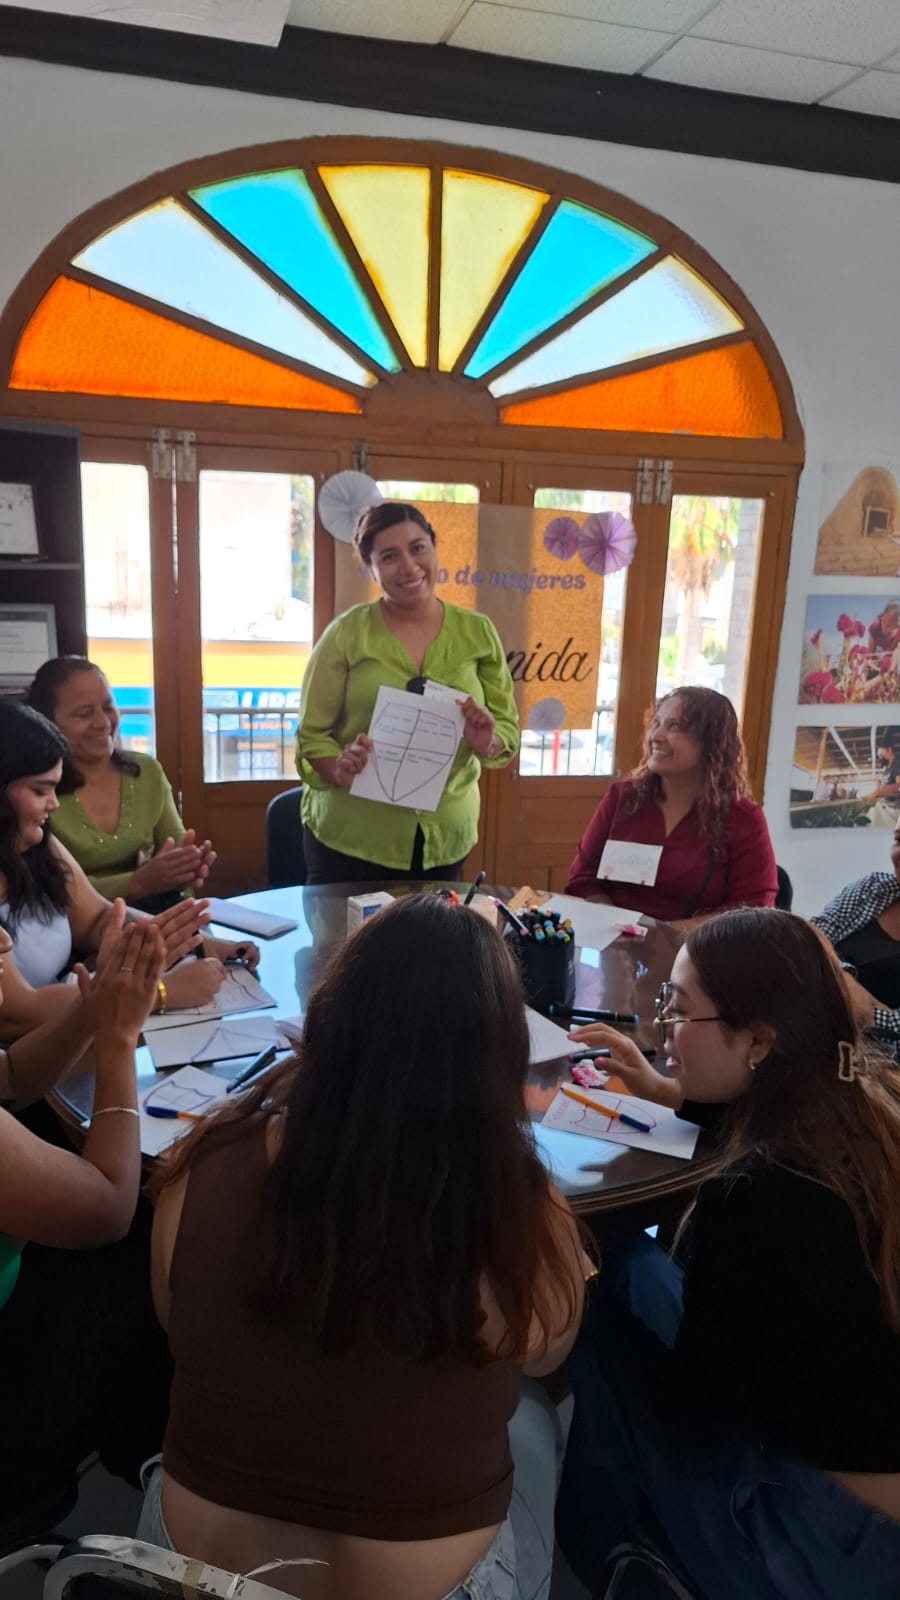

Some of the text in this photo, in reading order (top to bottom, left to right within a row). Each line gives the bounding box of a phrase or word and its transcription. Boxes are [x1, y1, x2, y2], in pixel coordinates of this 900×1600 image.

[455, 565, 484, 587] de
[489, 568, 586, 596] mujeres
[506, 637, 593, 683] nida
